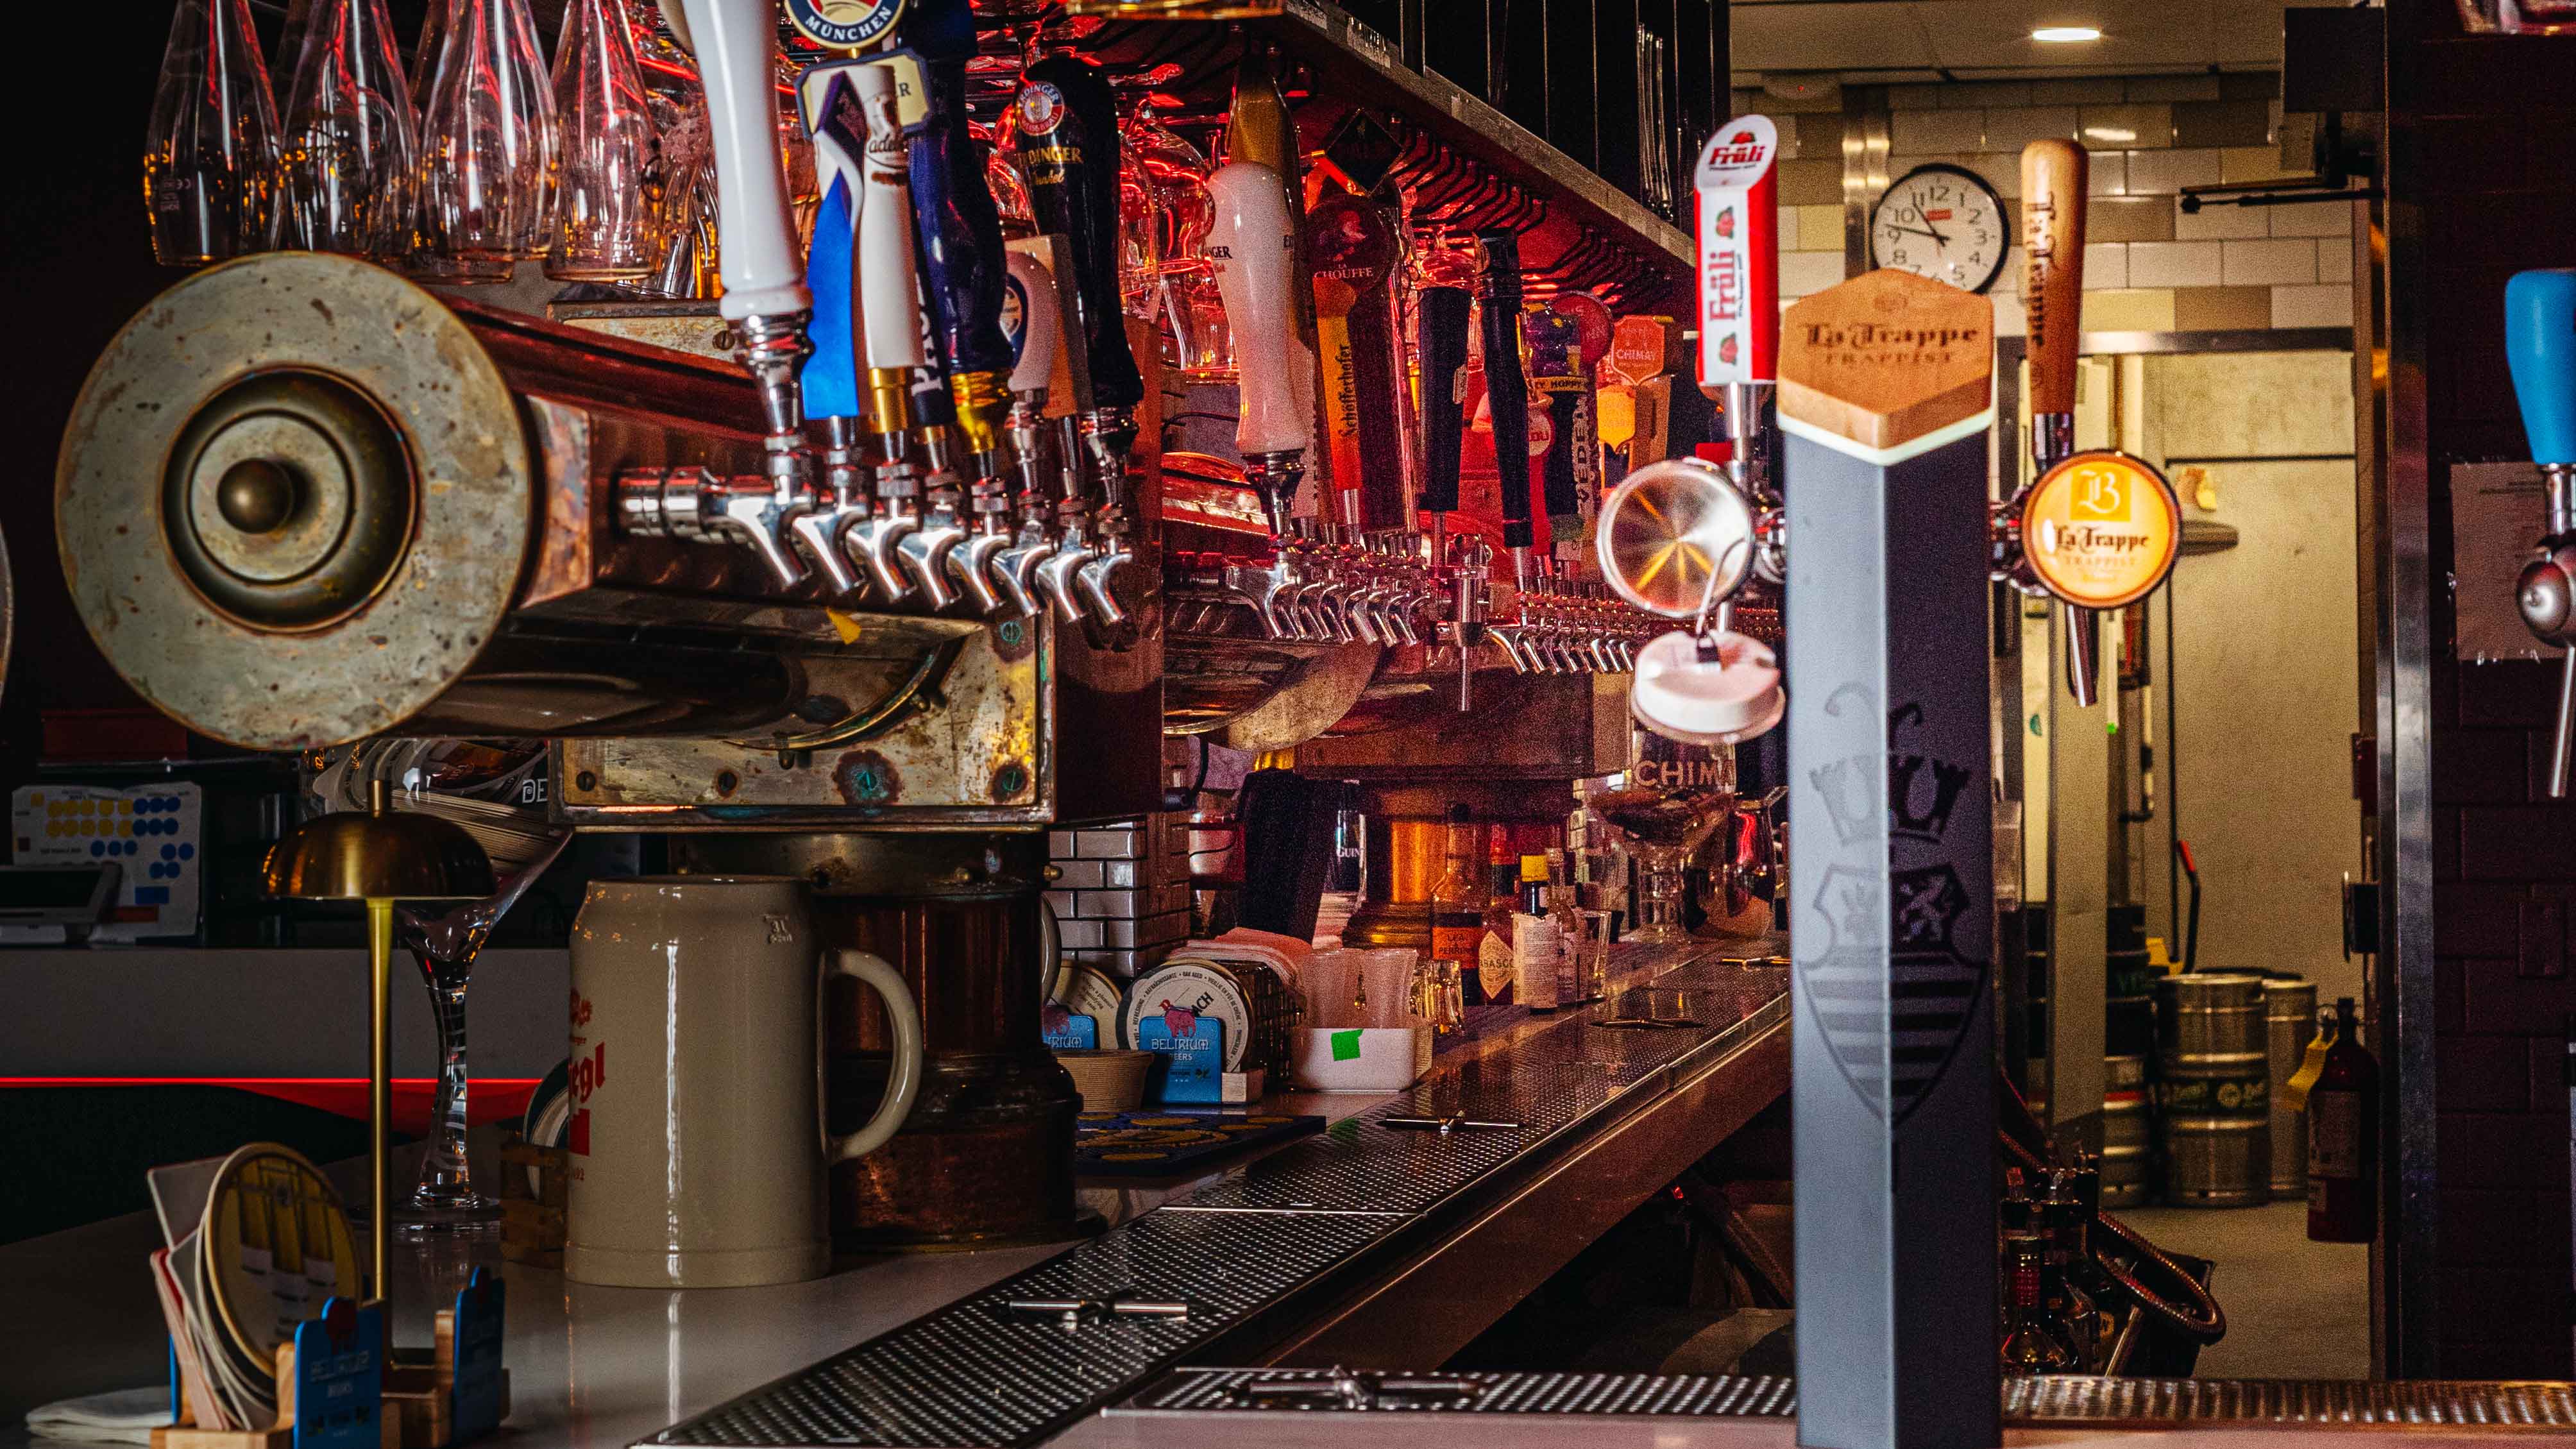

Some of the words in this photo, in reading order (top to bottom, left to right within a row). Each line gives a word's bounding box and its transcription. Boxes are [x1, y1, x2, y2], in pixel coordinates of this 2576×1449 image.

[806, 6, 892, 40] MÜNCHEN
[1019, 84, 1059, 105] RDINGER
[1709, 145, 1766, 165] Früli
[1929, 186, 1950, 201] 12
[1960, 192, 1964, 207] 1
[1895, 207, 1915, 223] 10
[1969, 208, 1982, 224] 2
[1888, 227, 1901, 244] 9
[1976, 228, 1988, 245] 3
[1893, 249, 1907, 266] 8
[1968, 251, 1980, 266] 4
[1953, 265, 1965, 280] 5
[1708, 250, 1737, 321] Früli
[1849, 323, 1978, 350] Trappe
[1616, 349, 1656, 360] CHIMAY
[2055, 525, 2076, 551] La
[2078, 525, 2149, 553] Trappe
[1151, 1038, 1211, 1051] DELIRIUM
[1170, 1053, 1193, 1061] EERS
